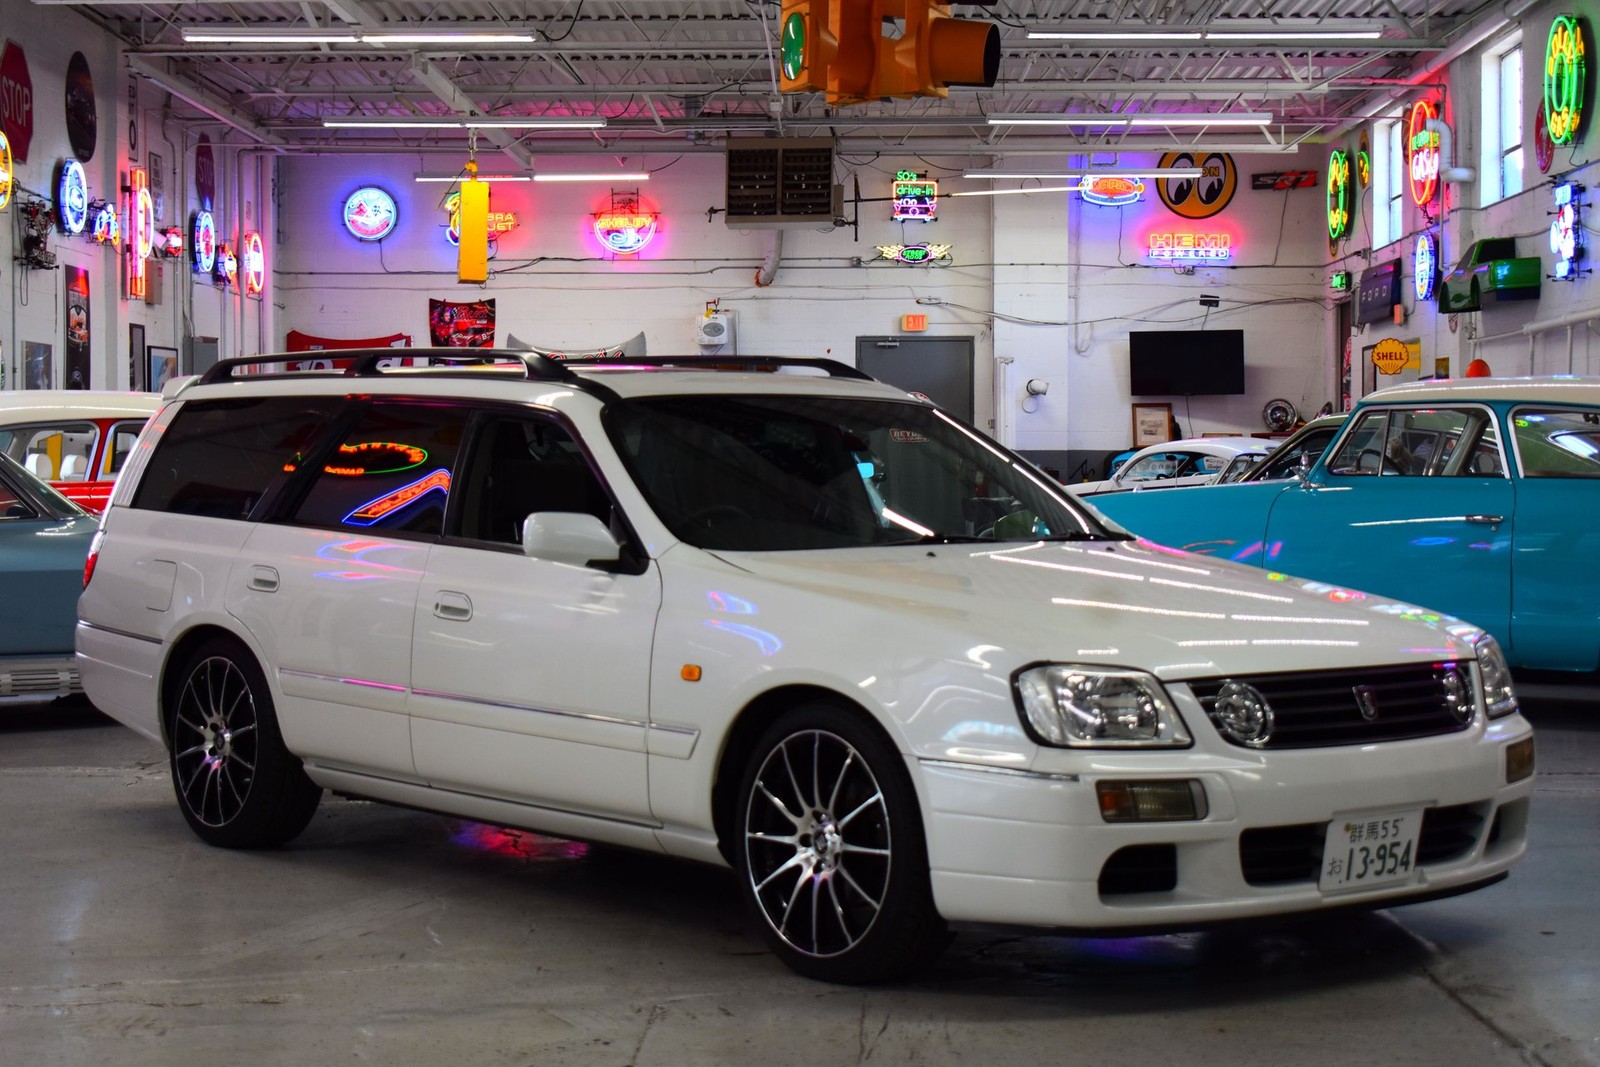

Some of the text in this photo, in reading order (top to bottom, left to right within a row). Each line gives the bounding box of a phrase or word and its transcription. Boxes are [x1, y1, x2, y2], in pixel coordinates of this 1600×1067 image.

[2, 75, 31, 127] STOP
[1150, 233, 1230, 249] HEMI
[1152, 250, 1228, 258] POWERED
[1361, 285, 1387, 303] FORD
[906, 314, 926, 330] EXIT
[1376, 351, 1404, 361] SHELL
[1326, 839, 1412, 880] お 13-954
